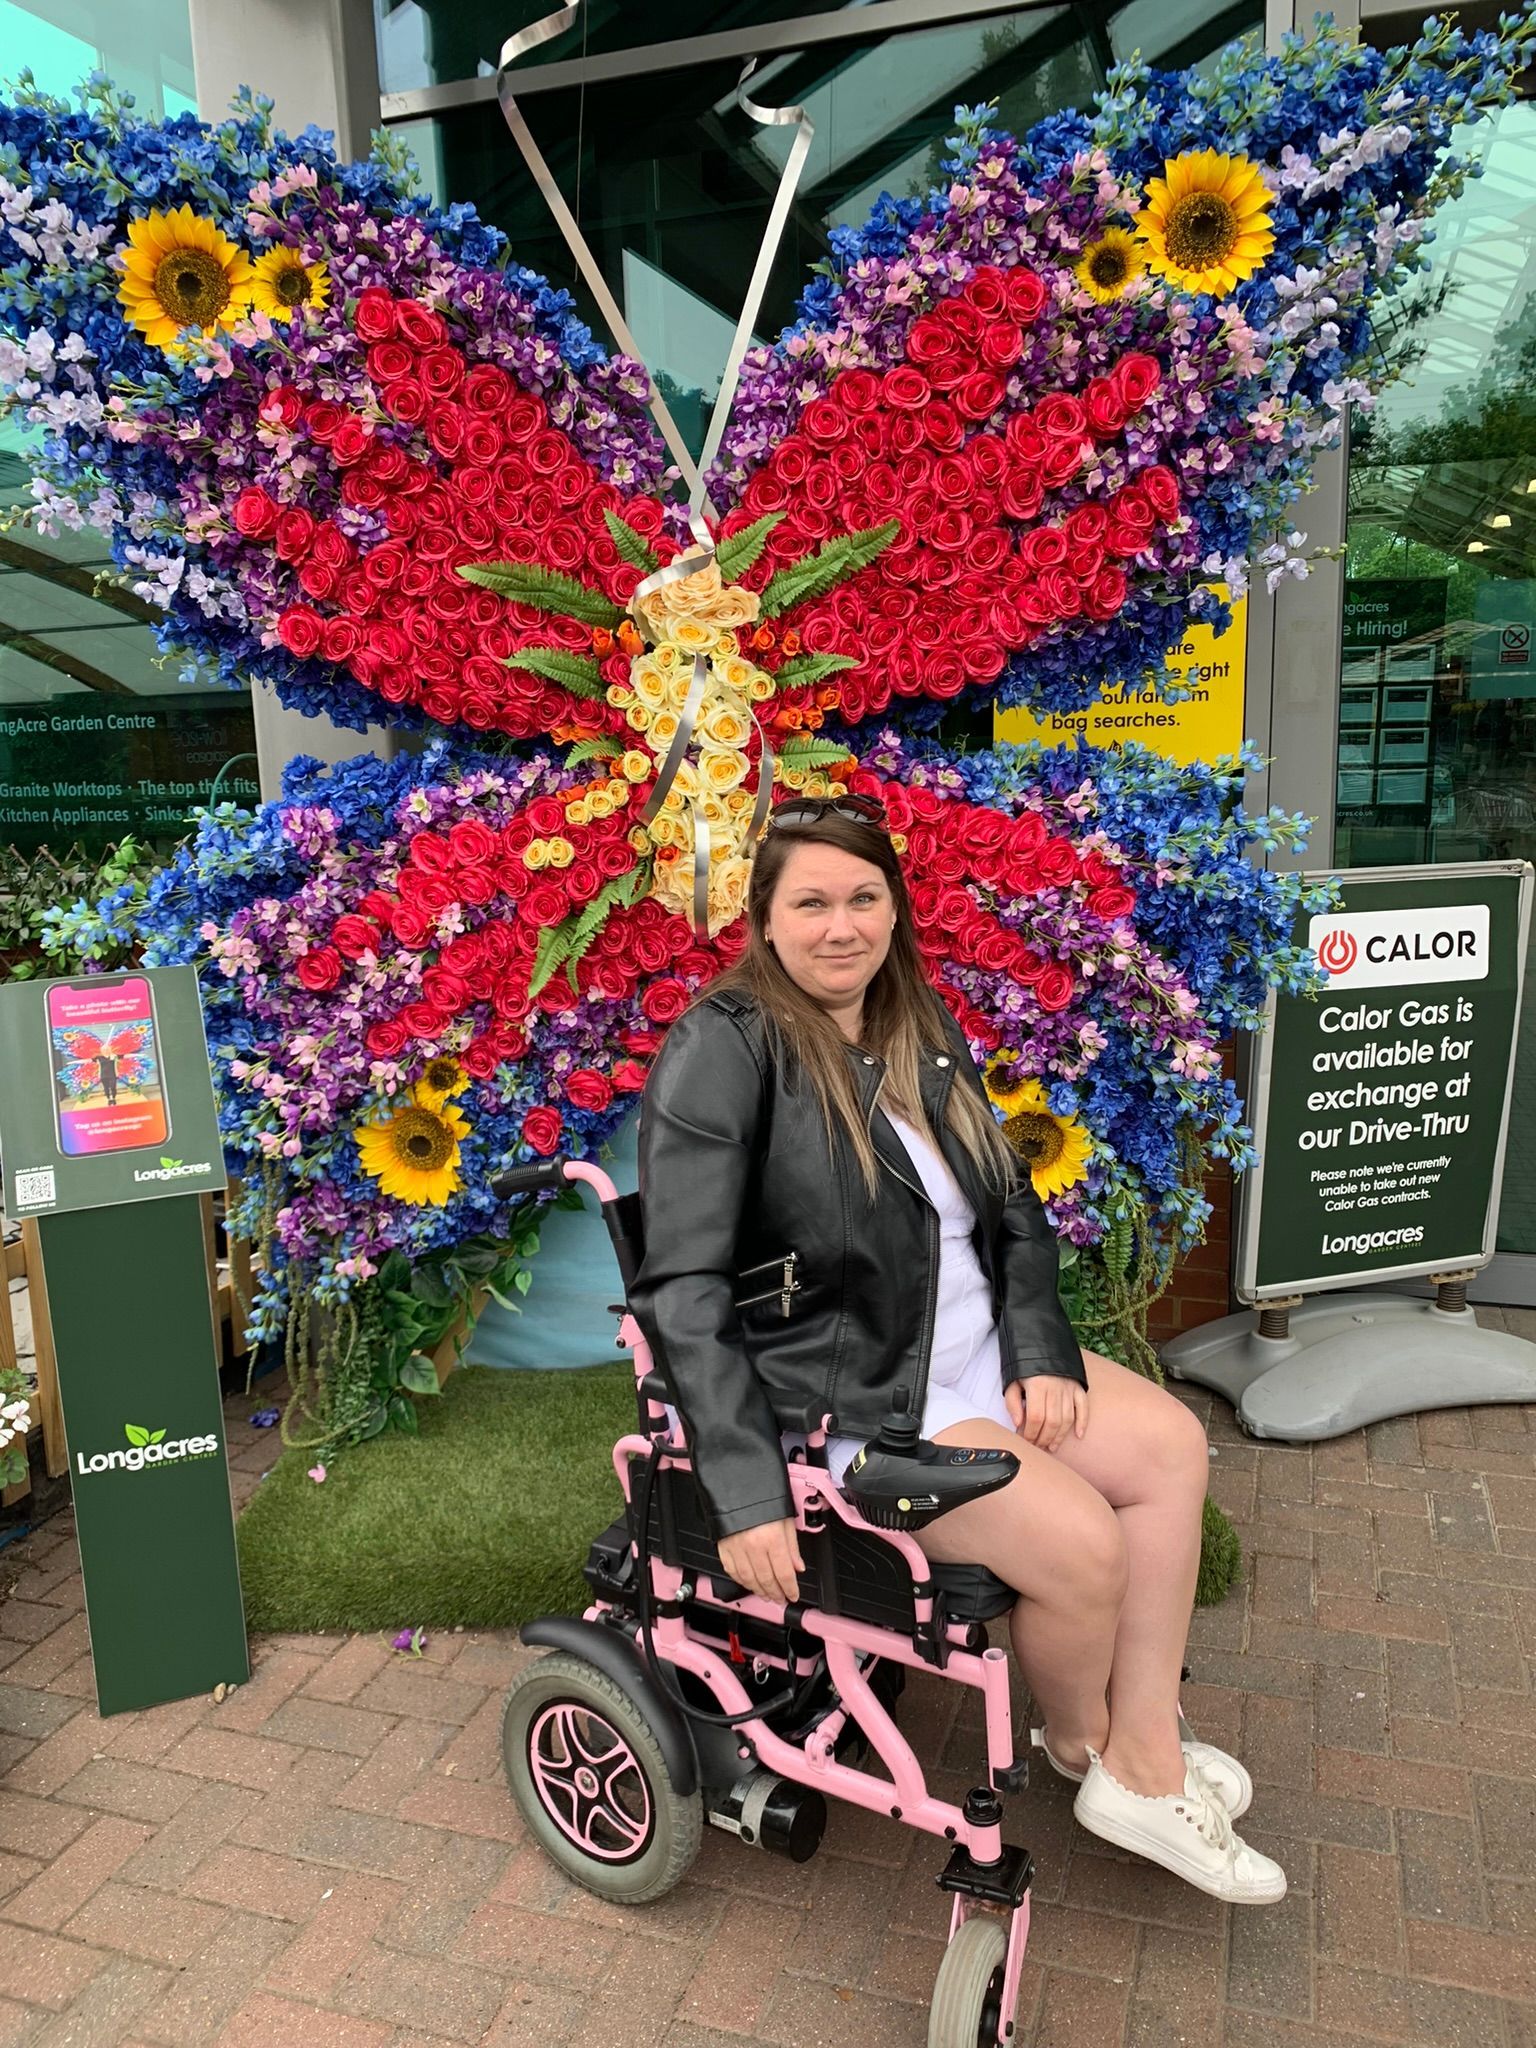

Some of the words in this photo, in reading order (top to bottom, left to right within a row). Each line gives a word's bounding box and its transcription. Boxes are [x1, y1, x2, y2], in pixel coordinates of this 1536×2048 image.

[1356, 620, 1408, 638] Hiring!
[51, 715, 103, 731] Garden
[107, 714, 156, 730] Centre
[1052, 715, 1088, 732] bag
[1094, 712, 1180, 728] searches.
[0, 782, 50, 798] Granite
[53, 780, 122, 799] Worktops
[137, 780, 166, 796] The
[169, 781, 195, 798] top
[199, 778, 231, 794] that
[233, 778, 259, 794] fits
[53, 806, 130, 825] Appliances
[145, 805, 183, 821] Sinks
[1366, 930, 1477, 963] CALOR
[1319, 1004, 1393, 1033] Calor
[1399, 1001, 1450, 1027] Gas
[1455, 996, 1474, 1022] is
[1312, 1039, 1435, 1072] available
[1440, 1036, 1473, 1061] for
[1307, 1082, 1439, 1111] exchange
[1445, 1072, 1471, 1098] at
[1298, 1127, 1343, 1150] our
[1349, 1112, 1470, 1146] Drive-Thru
[133, 1162, 212, 1182] Longacres
[1310, 1170, 1347, 1182] Please
[1349, 1165, 1374, 1178] note
[1377, 1162, 1405, 1175] we're
[1407, 1155, 1452, 1171] currently
[1319, 1183, 1358, 1197] unable
[1360, 1181, 1372, 1193] to
[1373, 1178, 1397, 1191] take
[1399, 1174, 1417, 1187] out
[1418, 1173, 1441, 1184] new
[1325, 1199, 1356, 1212] Calor
[1357, 1196, 1379, 1208] Gas
[1381, 1188, 1431, 1205] contracts.
[1321, 1226, 1425, 1255] Longacres
[77, 1433, 218, 1475] Longacres
